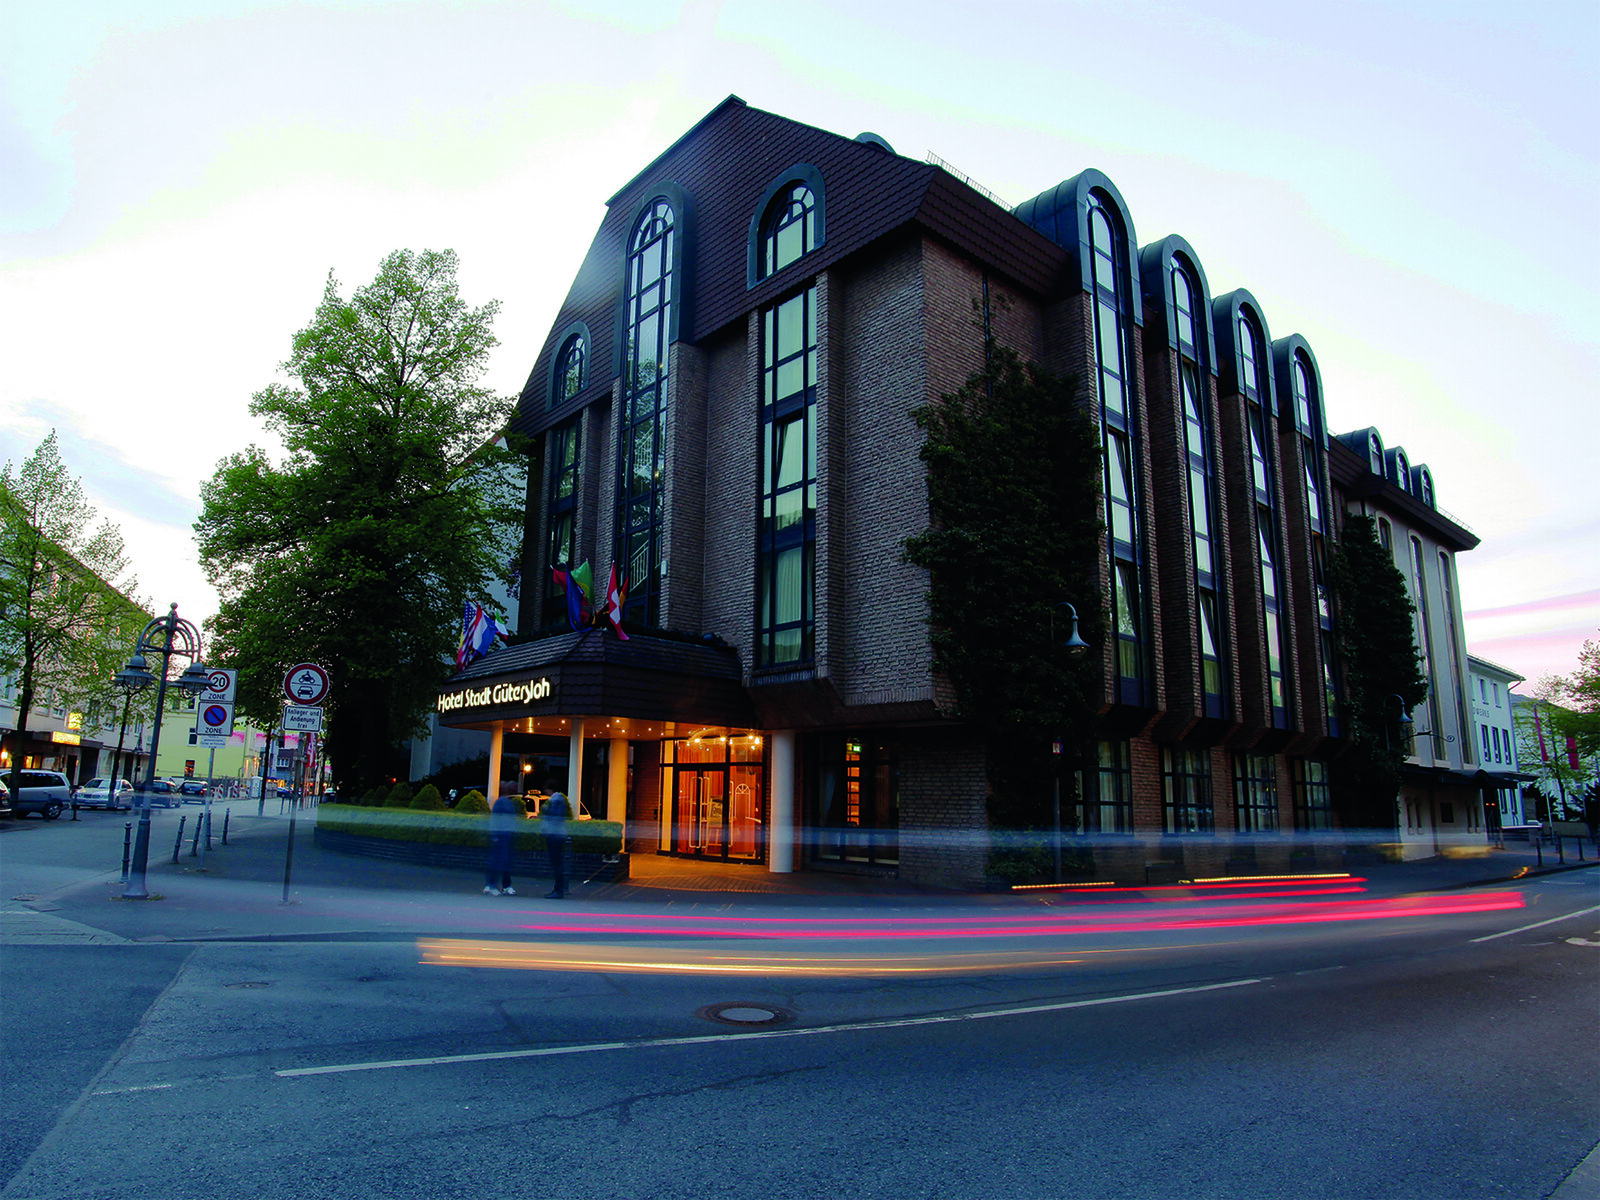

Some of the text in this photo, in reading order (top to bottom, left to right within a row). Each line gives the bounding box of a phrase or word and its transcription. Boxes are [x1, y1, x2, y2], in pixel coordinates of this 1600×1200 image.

[212, 676, 226, 688] 20
[437, 677, 550, 713] Hotel Stadt Gütersloh
